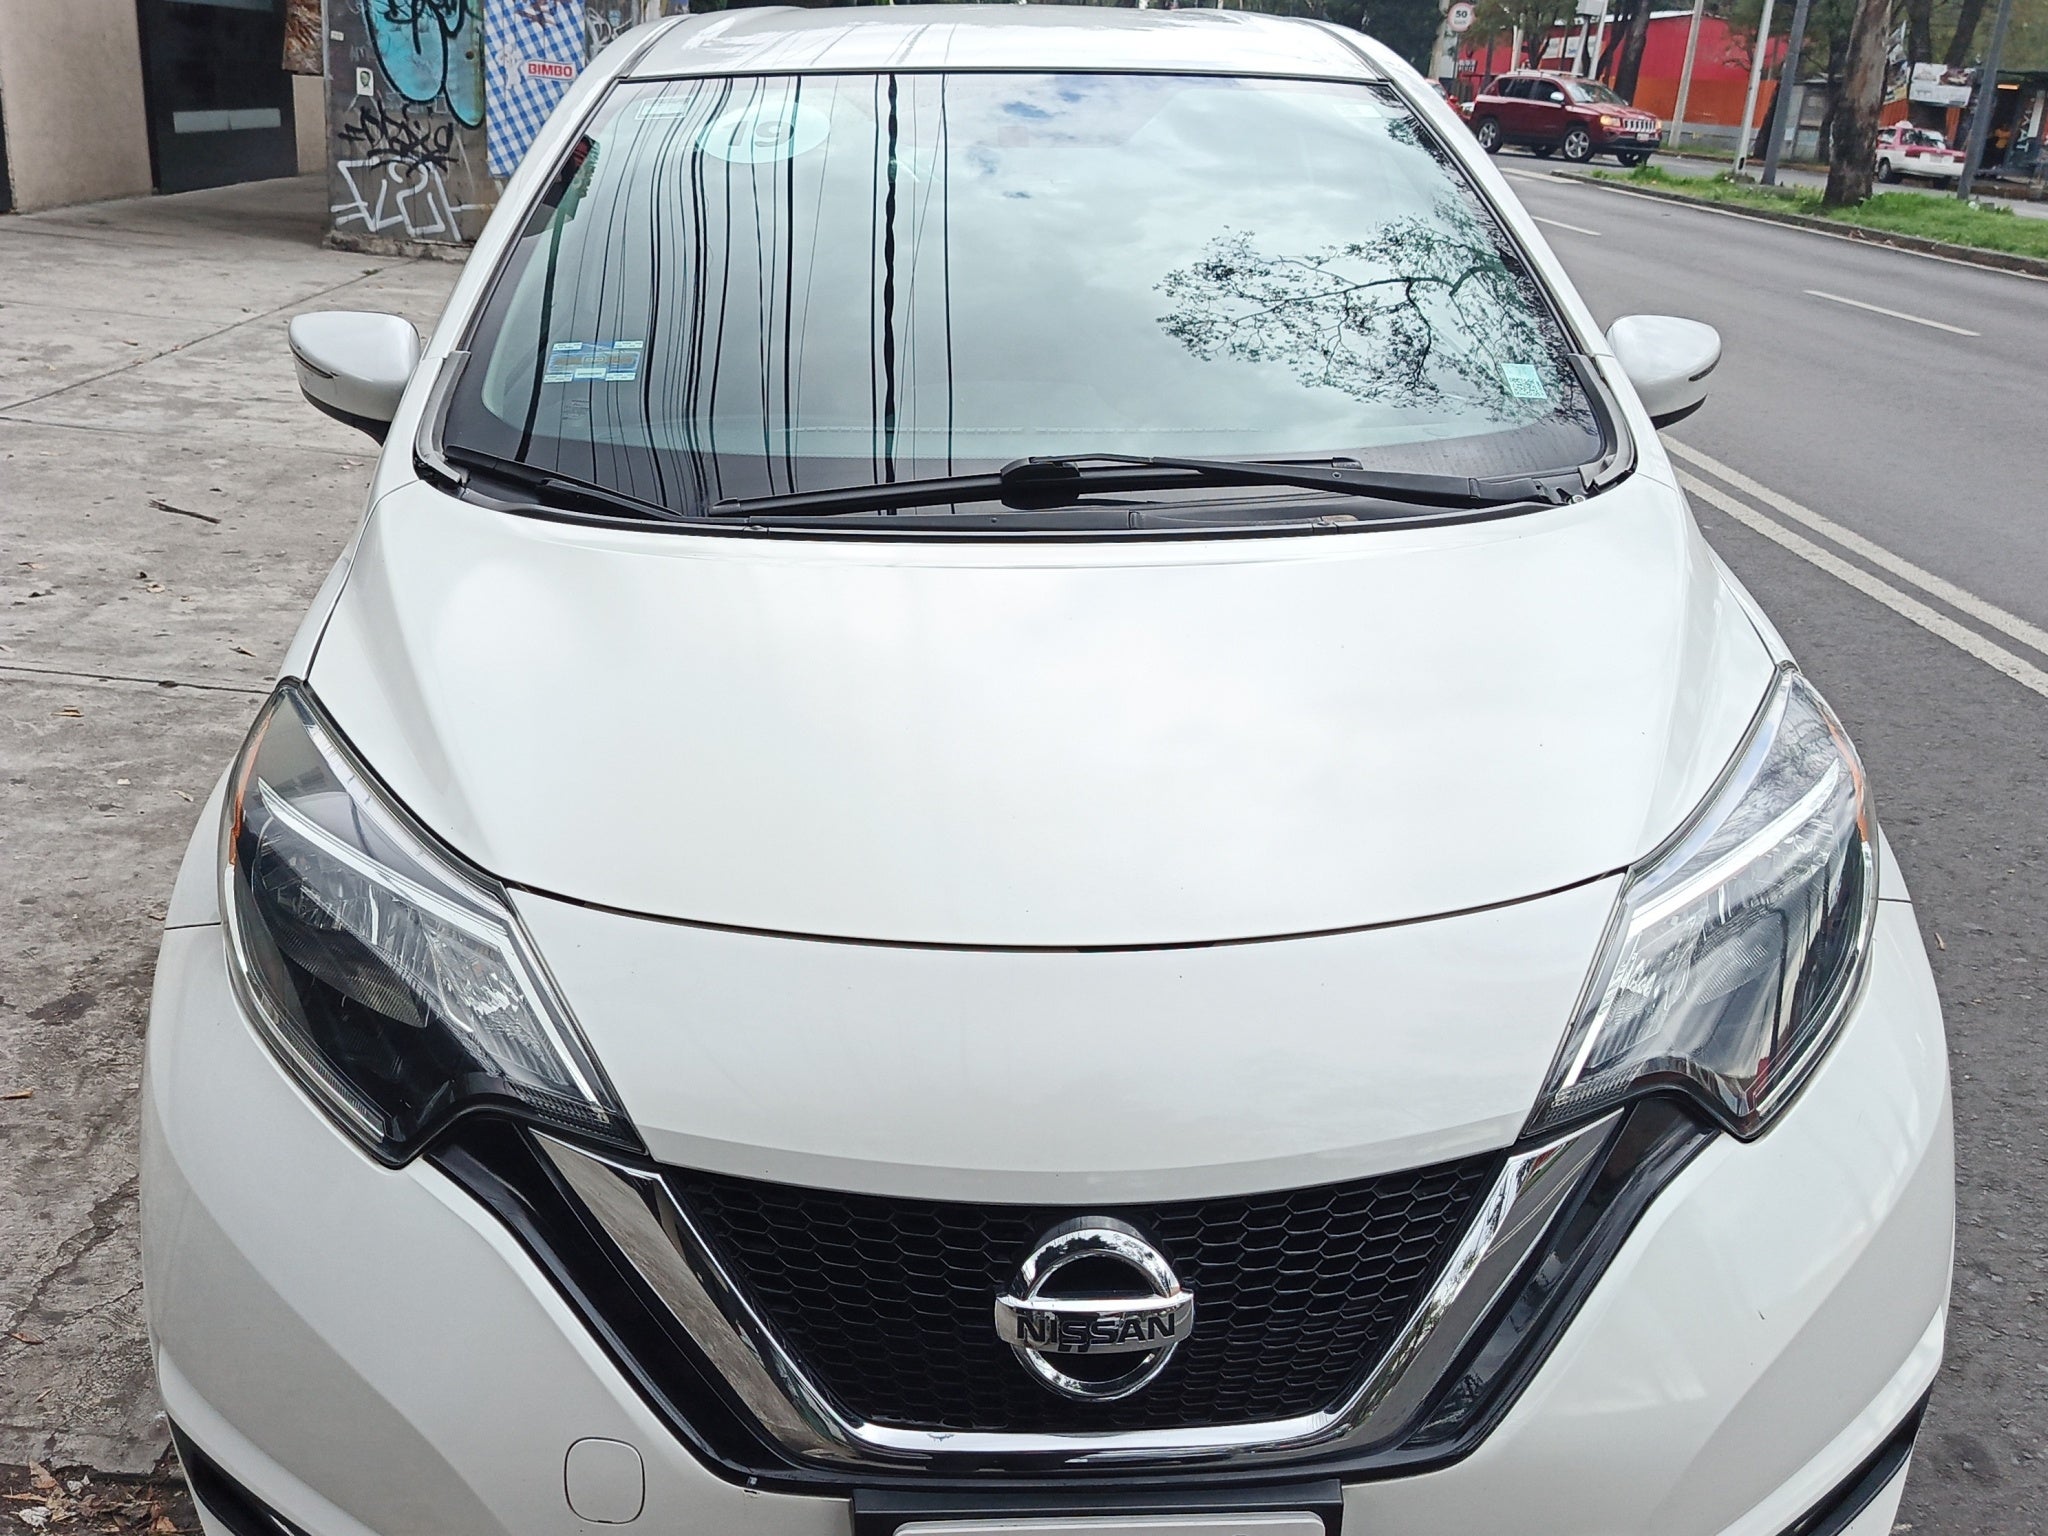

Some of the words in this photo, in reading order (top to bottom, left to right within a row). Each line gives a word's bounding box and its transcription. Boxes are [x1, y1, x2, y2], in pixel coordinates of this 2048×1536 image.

[1455, 10, 1468, 18] 50
[528, 63, 573, 77] BIMBO
[1016, 1312, 1176, 1346] NISSAN
